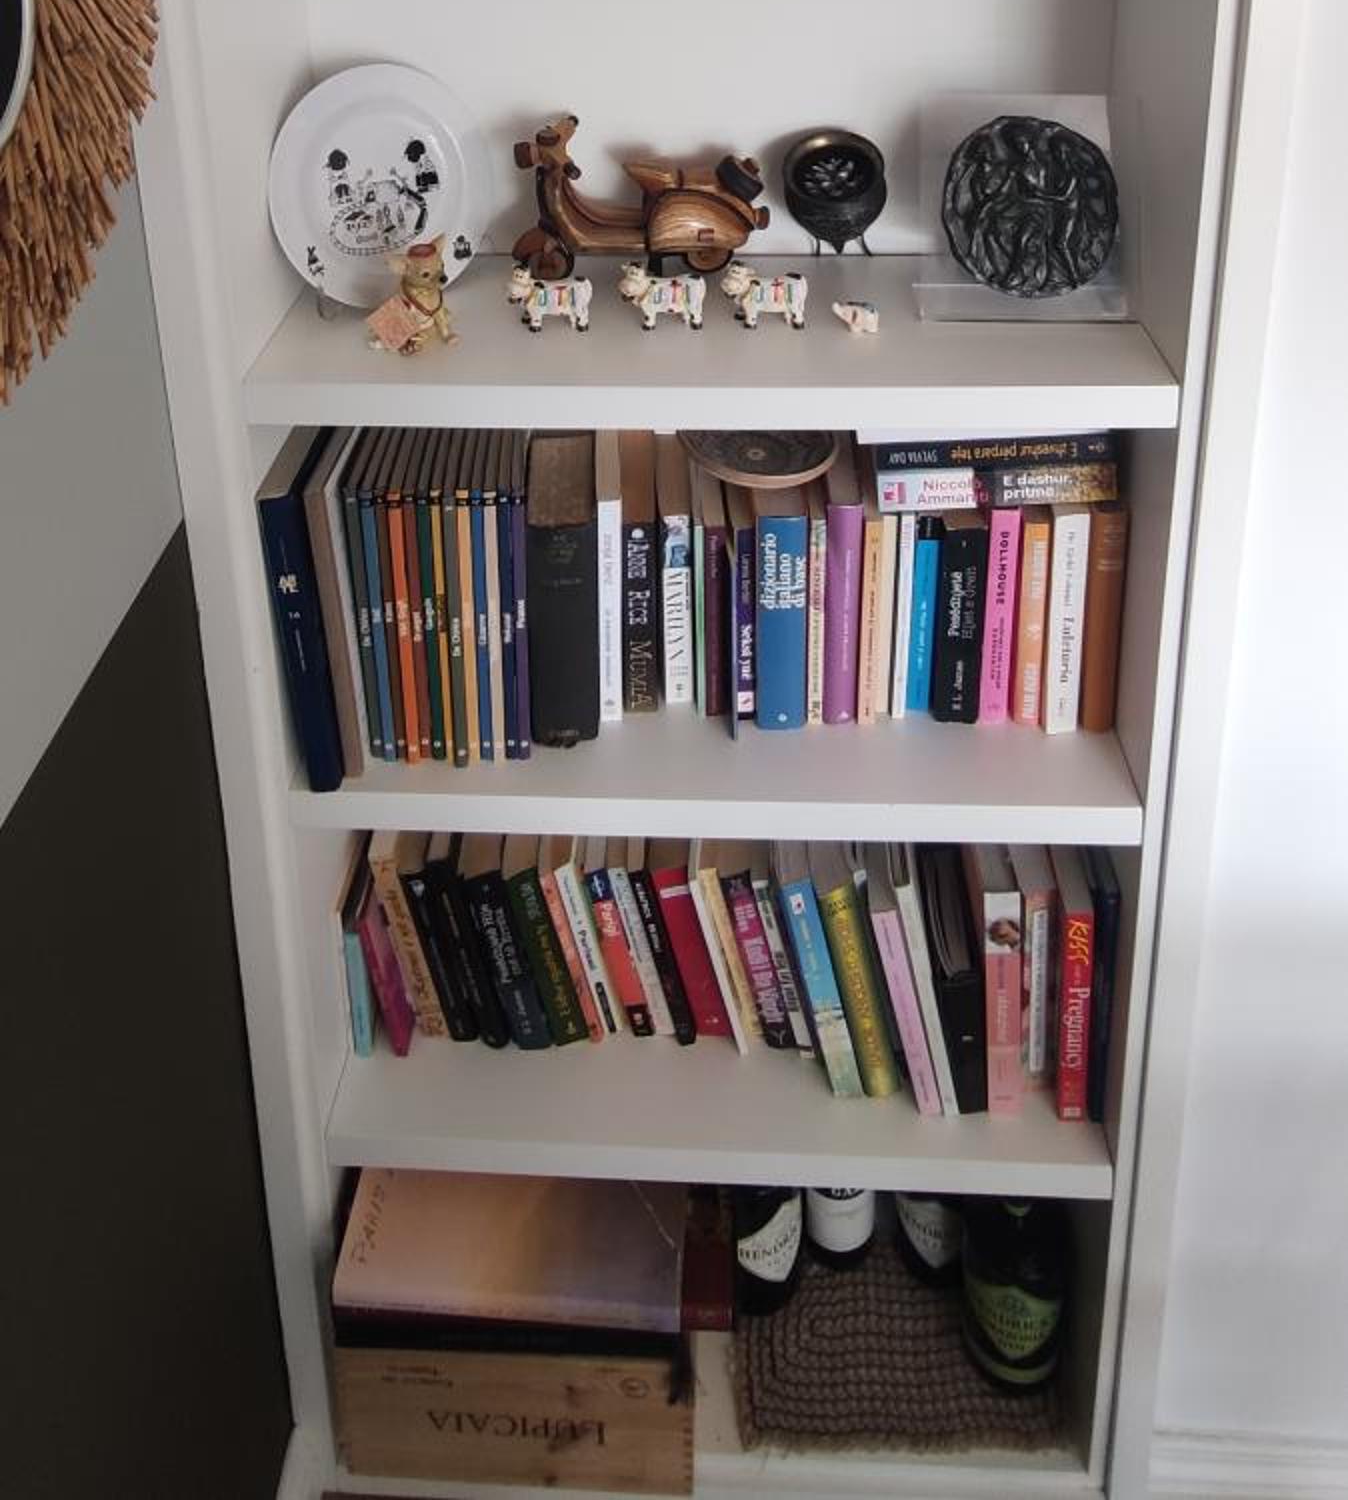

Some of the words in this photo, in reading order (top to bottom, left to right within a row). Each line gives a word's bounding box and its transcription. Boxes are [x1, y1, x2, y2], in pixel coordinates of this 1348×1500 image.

[627, 542, 650, 580] ANNE
[759, 532, 777, 609] dizionario
[777, 553, 792, 609] italiano
[793, 556, 806, 591] base
[995, 530, 1011, 606] DOLLHOUSE
[793, 593, 806, 609] di
[1063, 986, 1090, 1070] Pregnancy
[427, 1409, 607, 1446] LUPICAIA
